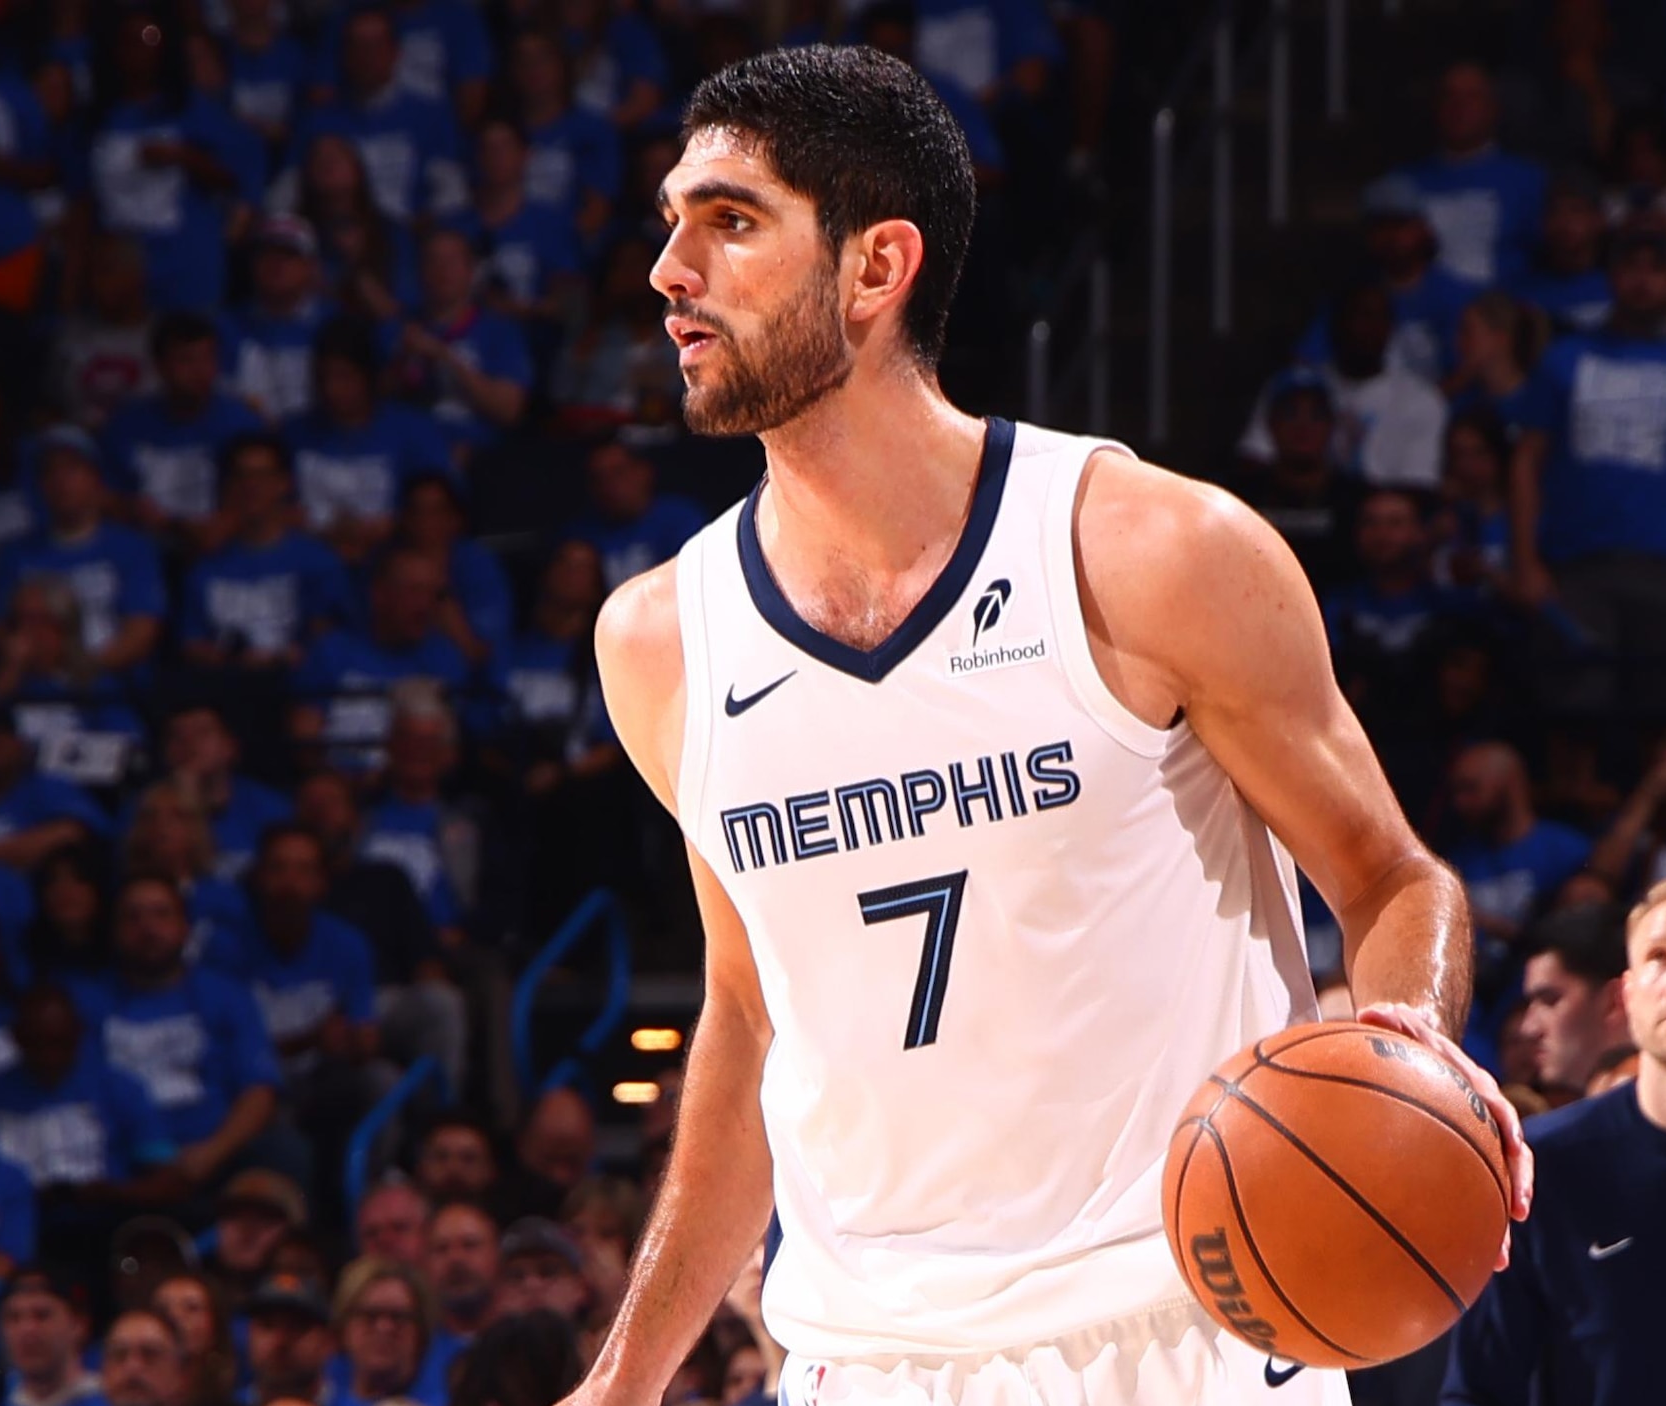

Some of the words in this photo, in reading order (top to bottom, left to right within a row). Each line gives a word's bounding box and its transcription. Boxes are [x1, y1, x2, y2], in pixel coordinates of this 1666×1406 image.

[950, 638, 1045, 673] Robinhood
[721, 741, 1081, 873] MEMPHIS
[856, 869, 969, 1051] 7
[1190, 1226, 1279, 1354] Wil
